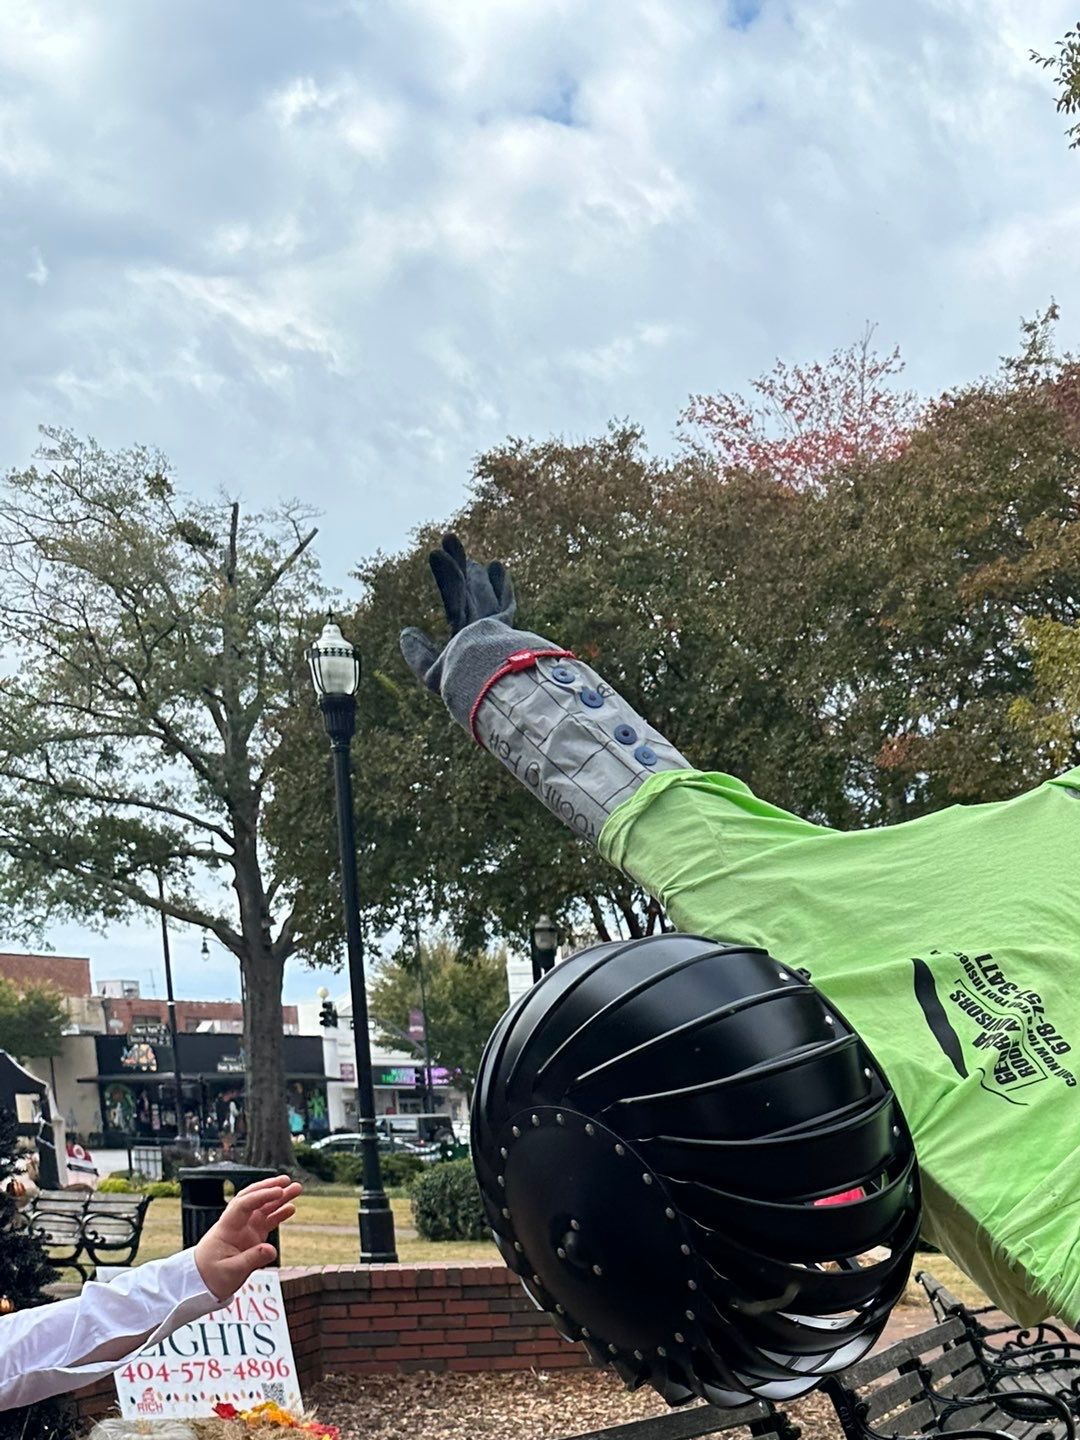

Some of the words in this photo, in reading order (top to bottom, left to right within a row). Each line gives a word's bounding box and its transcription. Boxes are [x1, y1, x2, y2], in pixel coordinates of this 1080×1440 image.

[974, 953, 1071, 1056] 678-751-3477
[1034, 1046, 1061, 1073] NOW
[120, 1357, 291, 1384] 404-578-4896
